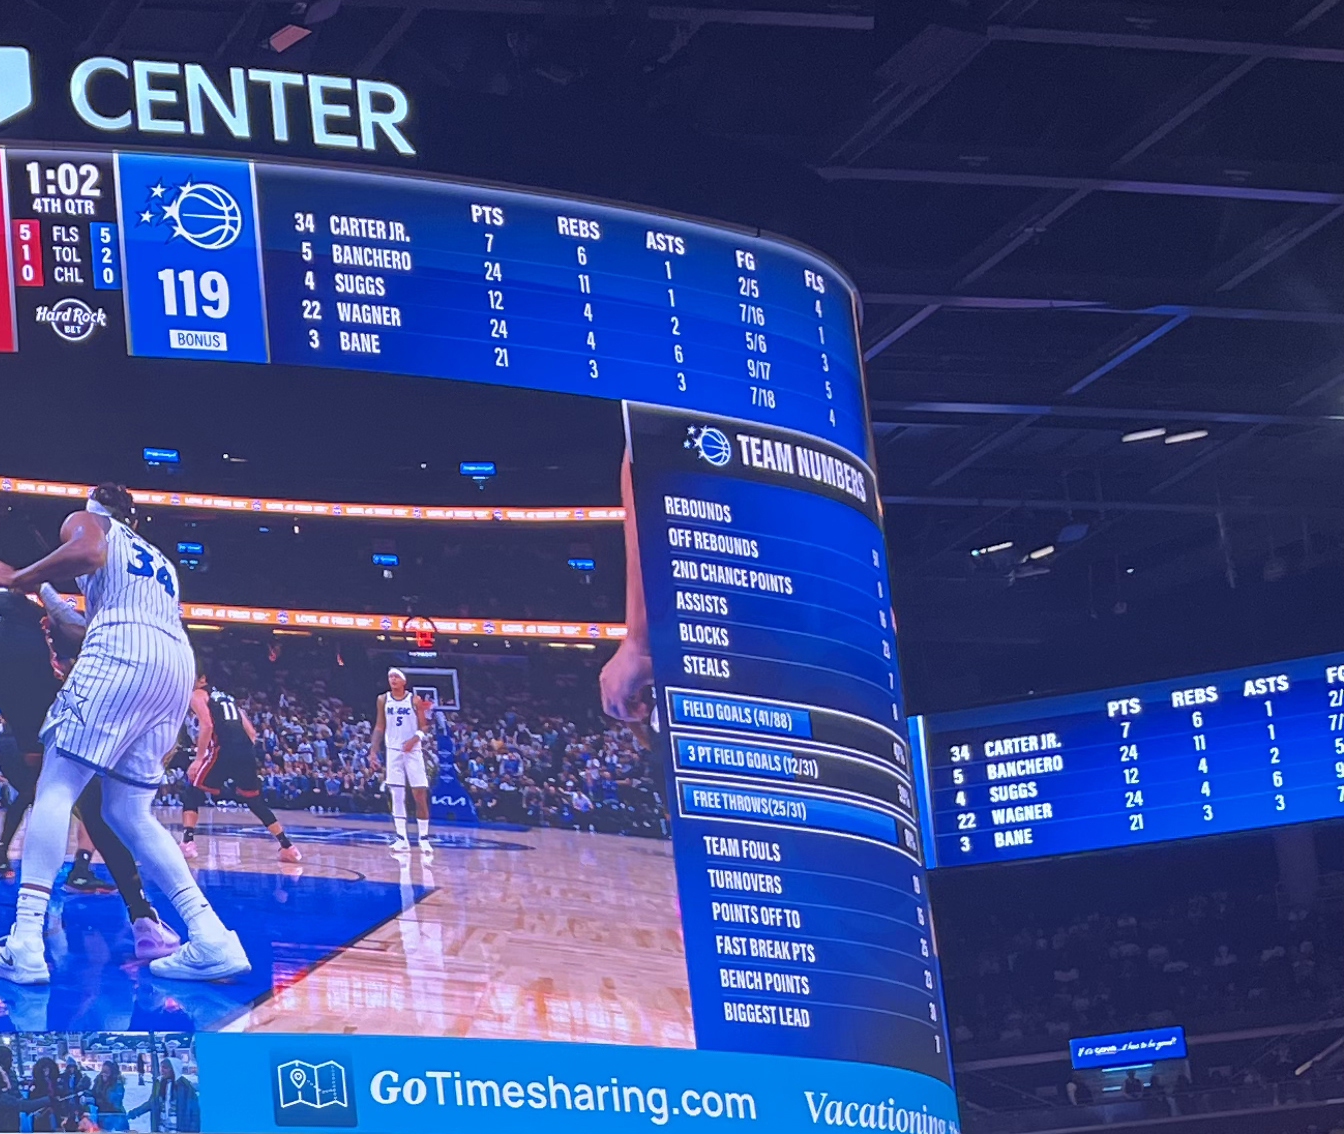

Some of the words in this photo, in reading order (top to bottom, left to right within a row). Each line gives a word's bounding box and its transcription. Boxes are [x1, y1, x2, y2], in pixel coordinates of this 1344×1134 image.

[69, 56, 417, 156] CENTER
[26, 162, 101, 197] 1:02
[32, 197, 62, 214] 4TH
[64, 198, 95, 216] QTR
[19, 223, 31, 241] 5
[52, 225, 80, 243] FLS
[100, 227, 111, 244] 5
[294, 212, 315, 233] 34
[329, 215, 387, 240] CARTER
[388, 221, 411, 243] JR.
[21, 244, 30, 261] 1
[52, 245, 82, 263] TOL
[101, 247, 113, 264] 2
[301, 241, 313, 262] 5
[331, 243, 412, 271] BANCHERO
[470, 204, 504, 226] PTS
[557, 216, 601, 240] REBS
[646, 231, 685, 255] ASTS
[735, 249, 756, 271] FG
[804, 269, 825, 294] FLS
[22, 264, 34, 282] 0
[54, 266, 84, 283] CHL
[102, 267, 114, 284] 0
[304, 270, 315, 291] 4
[334, 272, 386, 297] SUGGS
[157, 268, 230, 319] 119
[36, 306, 71, 322] Hard
[73, 307, 106, 326] Rock
[301, 299, 322, 320] 22
[336, 301, 402, 327] WAGNER
[175, 332, 221, 349] BONUS
[308, 328, 320, 349] 3
[339, 331, 381, 354] BANE
[127, 542, 176, 599] 34
[1107, 697, 1142, 718] PTS
[1171, 685, 1219, 708] REBS
[1243, 674, 1290, 697] ASTS
[222, 701, 239, 721] 11
[396, 716, 403, 727] 5
[957, 812, 977, 830] 22
[991, 802, 1053, 825] WAGNER
[370, 1070, 757, 1126] GoTimesharing.com
